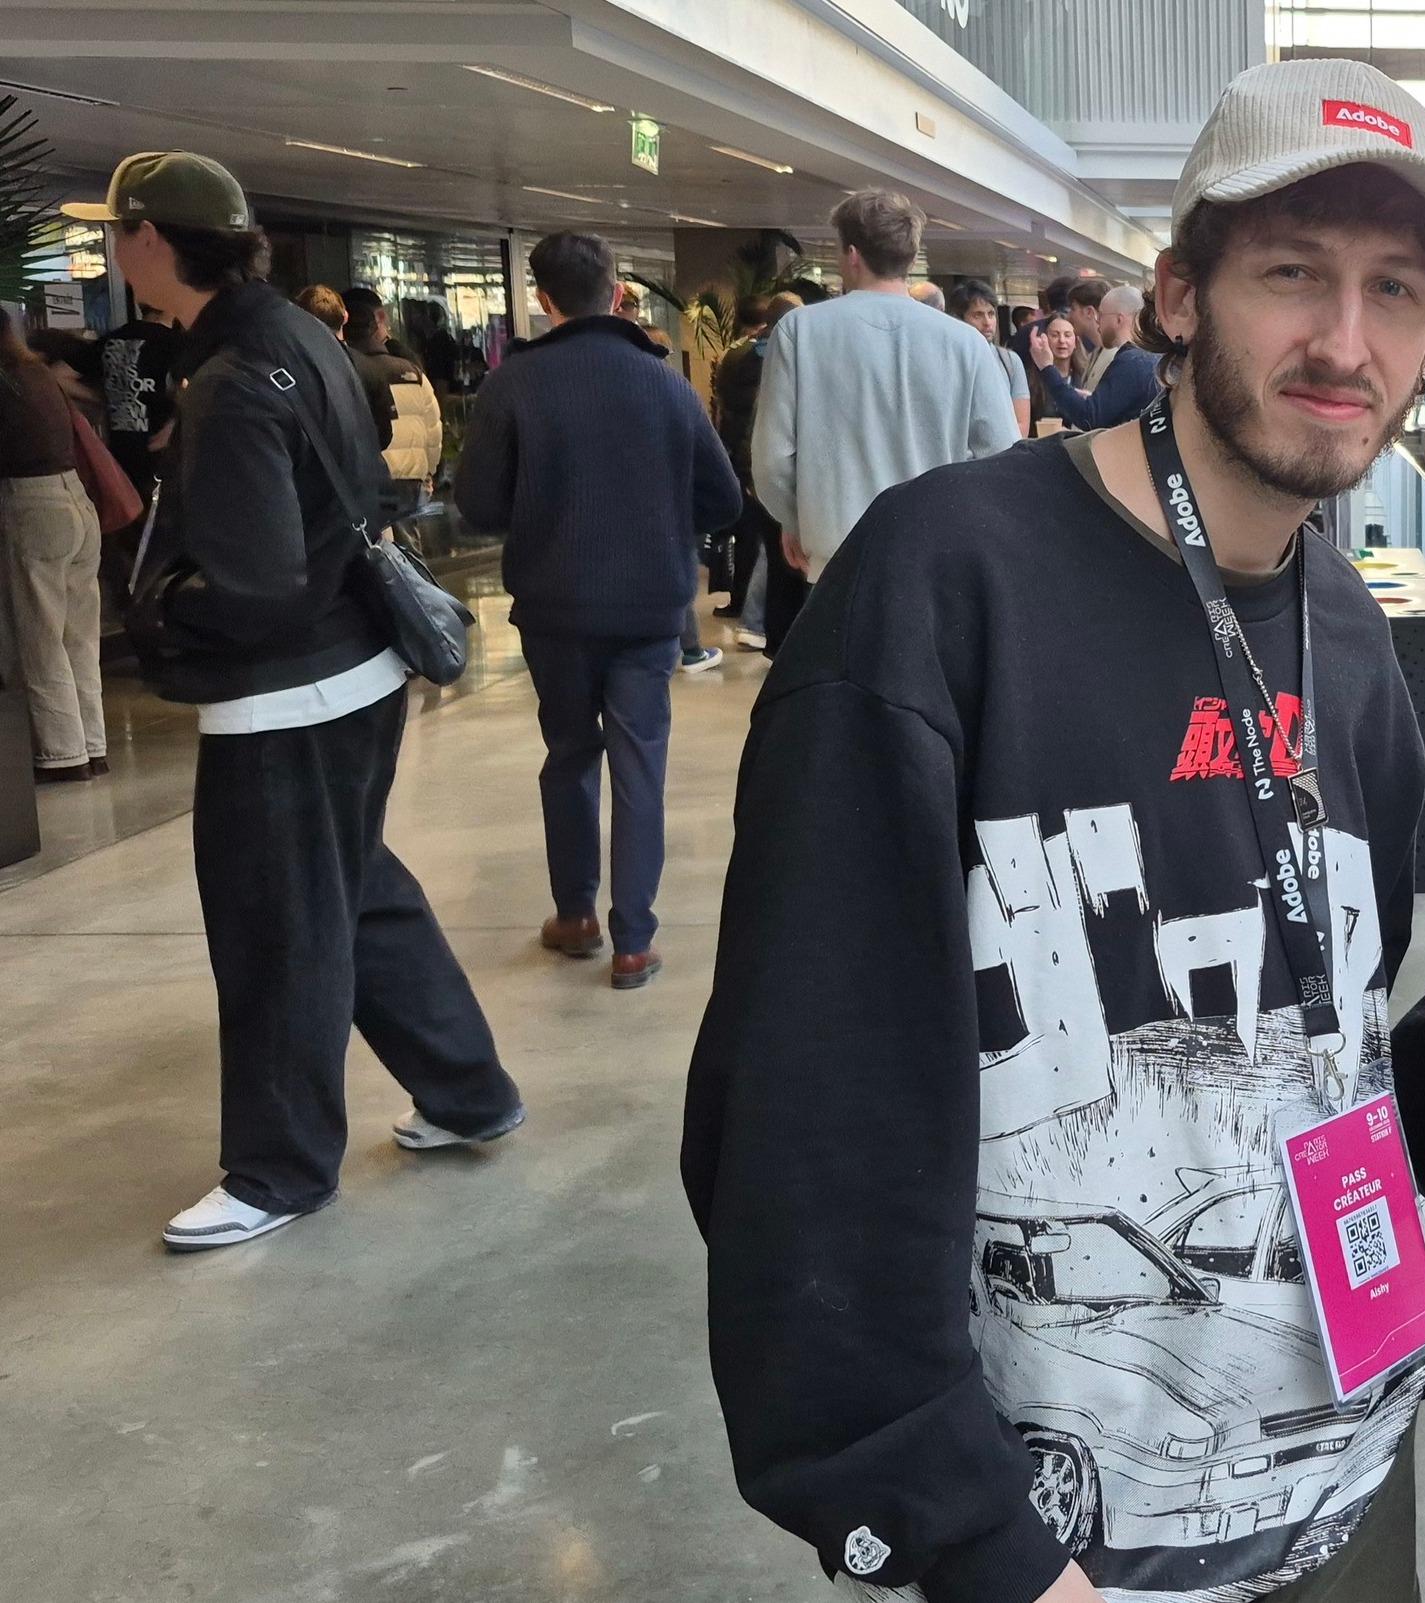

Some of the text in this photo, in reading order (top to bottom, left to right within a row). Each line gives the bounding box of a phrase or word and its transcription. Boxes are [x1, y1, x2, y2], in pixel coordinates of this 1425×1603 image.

[1336, 108, 1400, 136] Adobe
[1167, 473, 1206, 547] Adobe
[1241, 708, 1259, 748] Node
[1252, 748, 1265, 776] The
[1276, 849, 1308, 923] Adobe
[1366, 1105, 1388, 1126] 9-10
[1307, 1149, 1330, 1166] WEEK
[1341, 1167, 1367, 1189] PASS
[1333, 1178, 1382, 1211] CRÉATEUR
